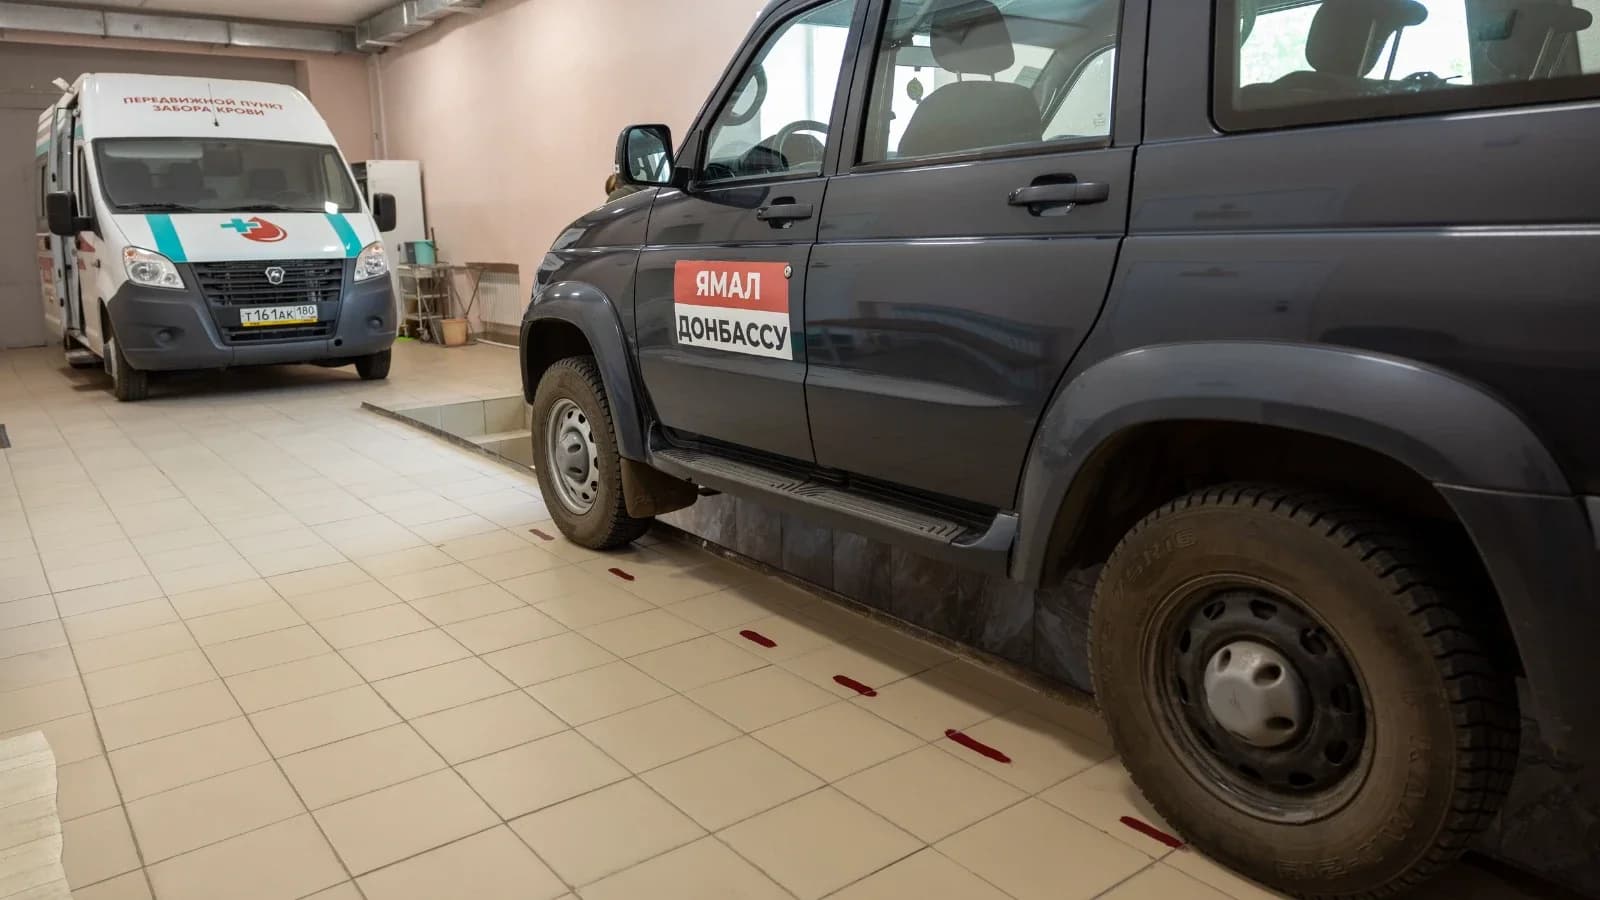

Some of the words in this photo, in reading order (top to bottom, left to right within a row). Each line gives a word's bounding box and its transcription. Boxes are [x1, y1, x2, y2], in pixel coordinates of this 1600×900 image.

[123, 97, 236, 106] ПЕРЕДВИЖНОЙ
[241, 99, 284, 111] ПУНКТ
[153, 105, 212, 113] ЗАБОРА
[217, 106, 265, 116] КРОВИ
[696, 270, 761, 300] ЯМАЛ
[679, 315, 787, 351] ДОНБАССУ
